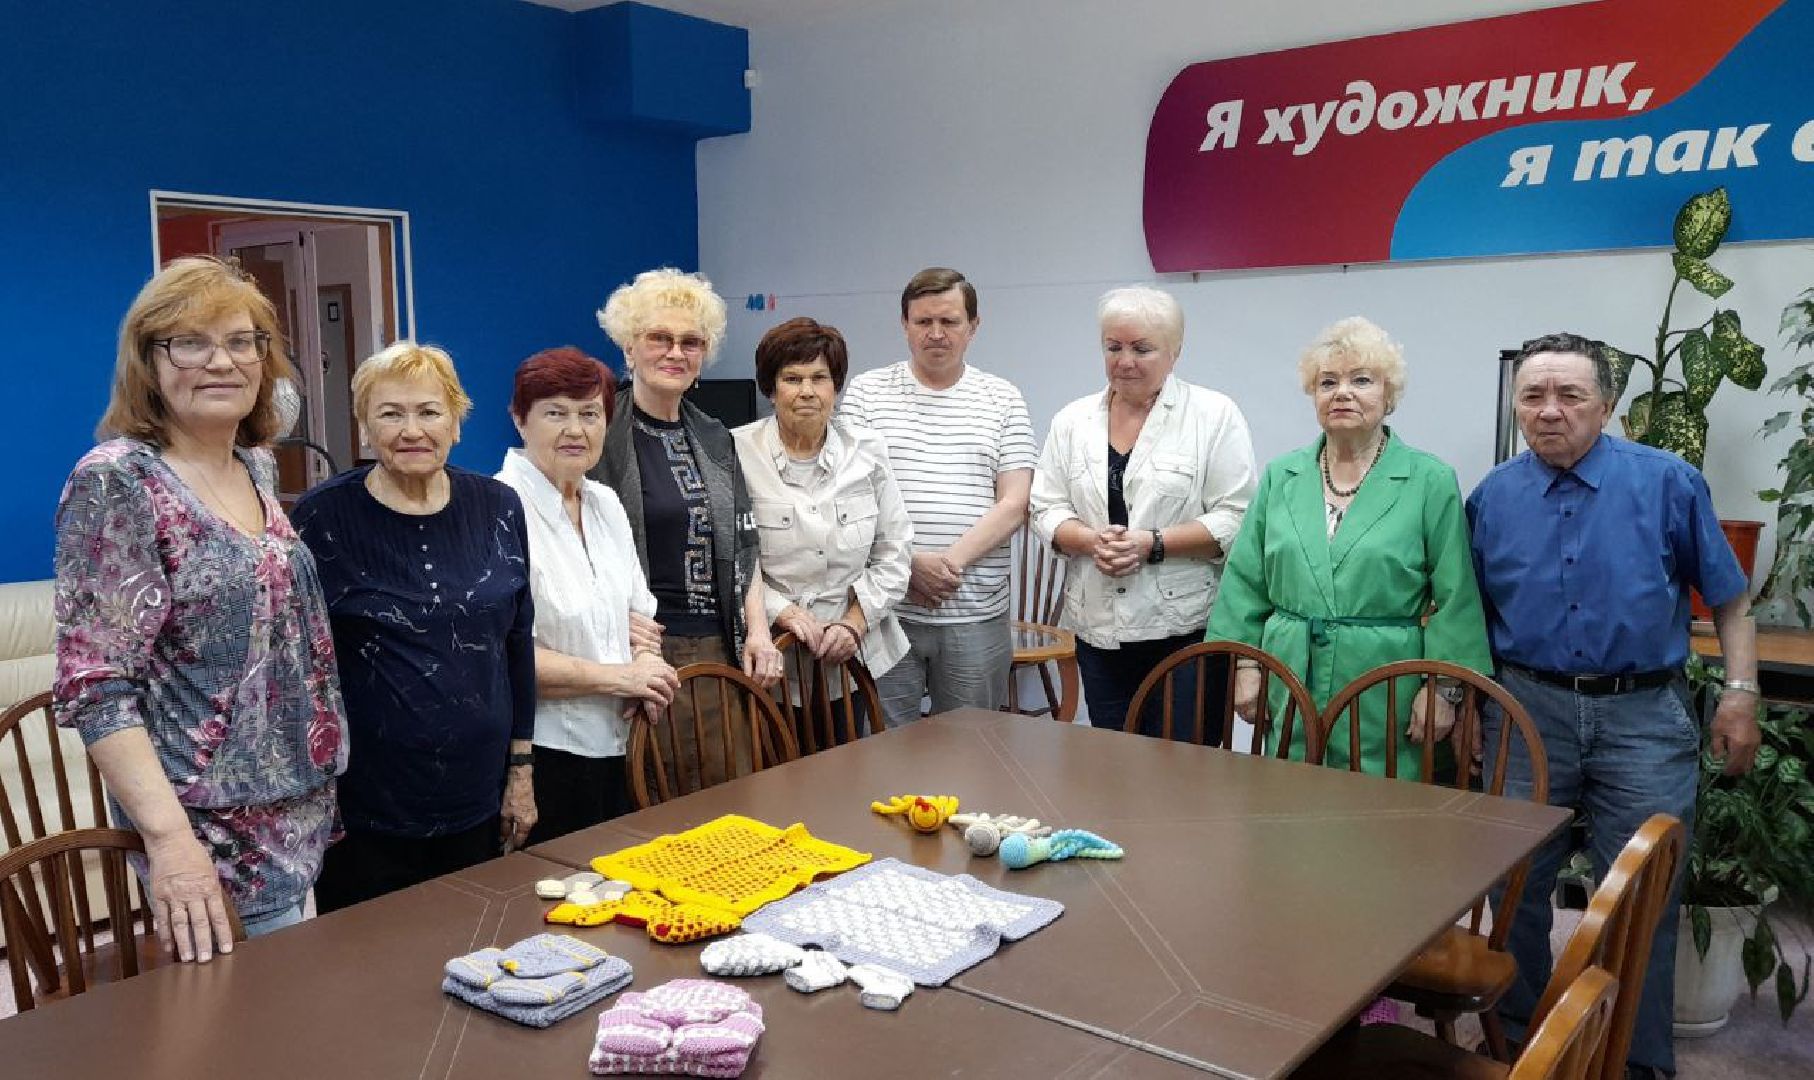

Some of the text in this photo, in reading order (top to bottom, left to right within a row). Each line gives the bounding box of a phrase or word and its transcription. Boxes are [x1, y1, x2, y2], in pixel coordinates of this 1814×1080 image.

[1199, 62, 1654, 156] Я художник,
[1501, 145, 1553, 188] я
[1573, 123, 1771, 181] так
